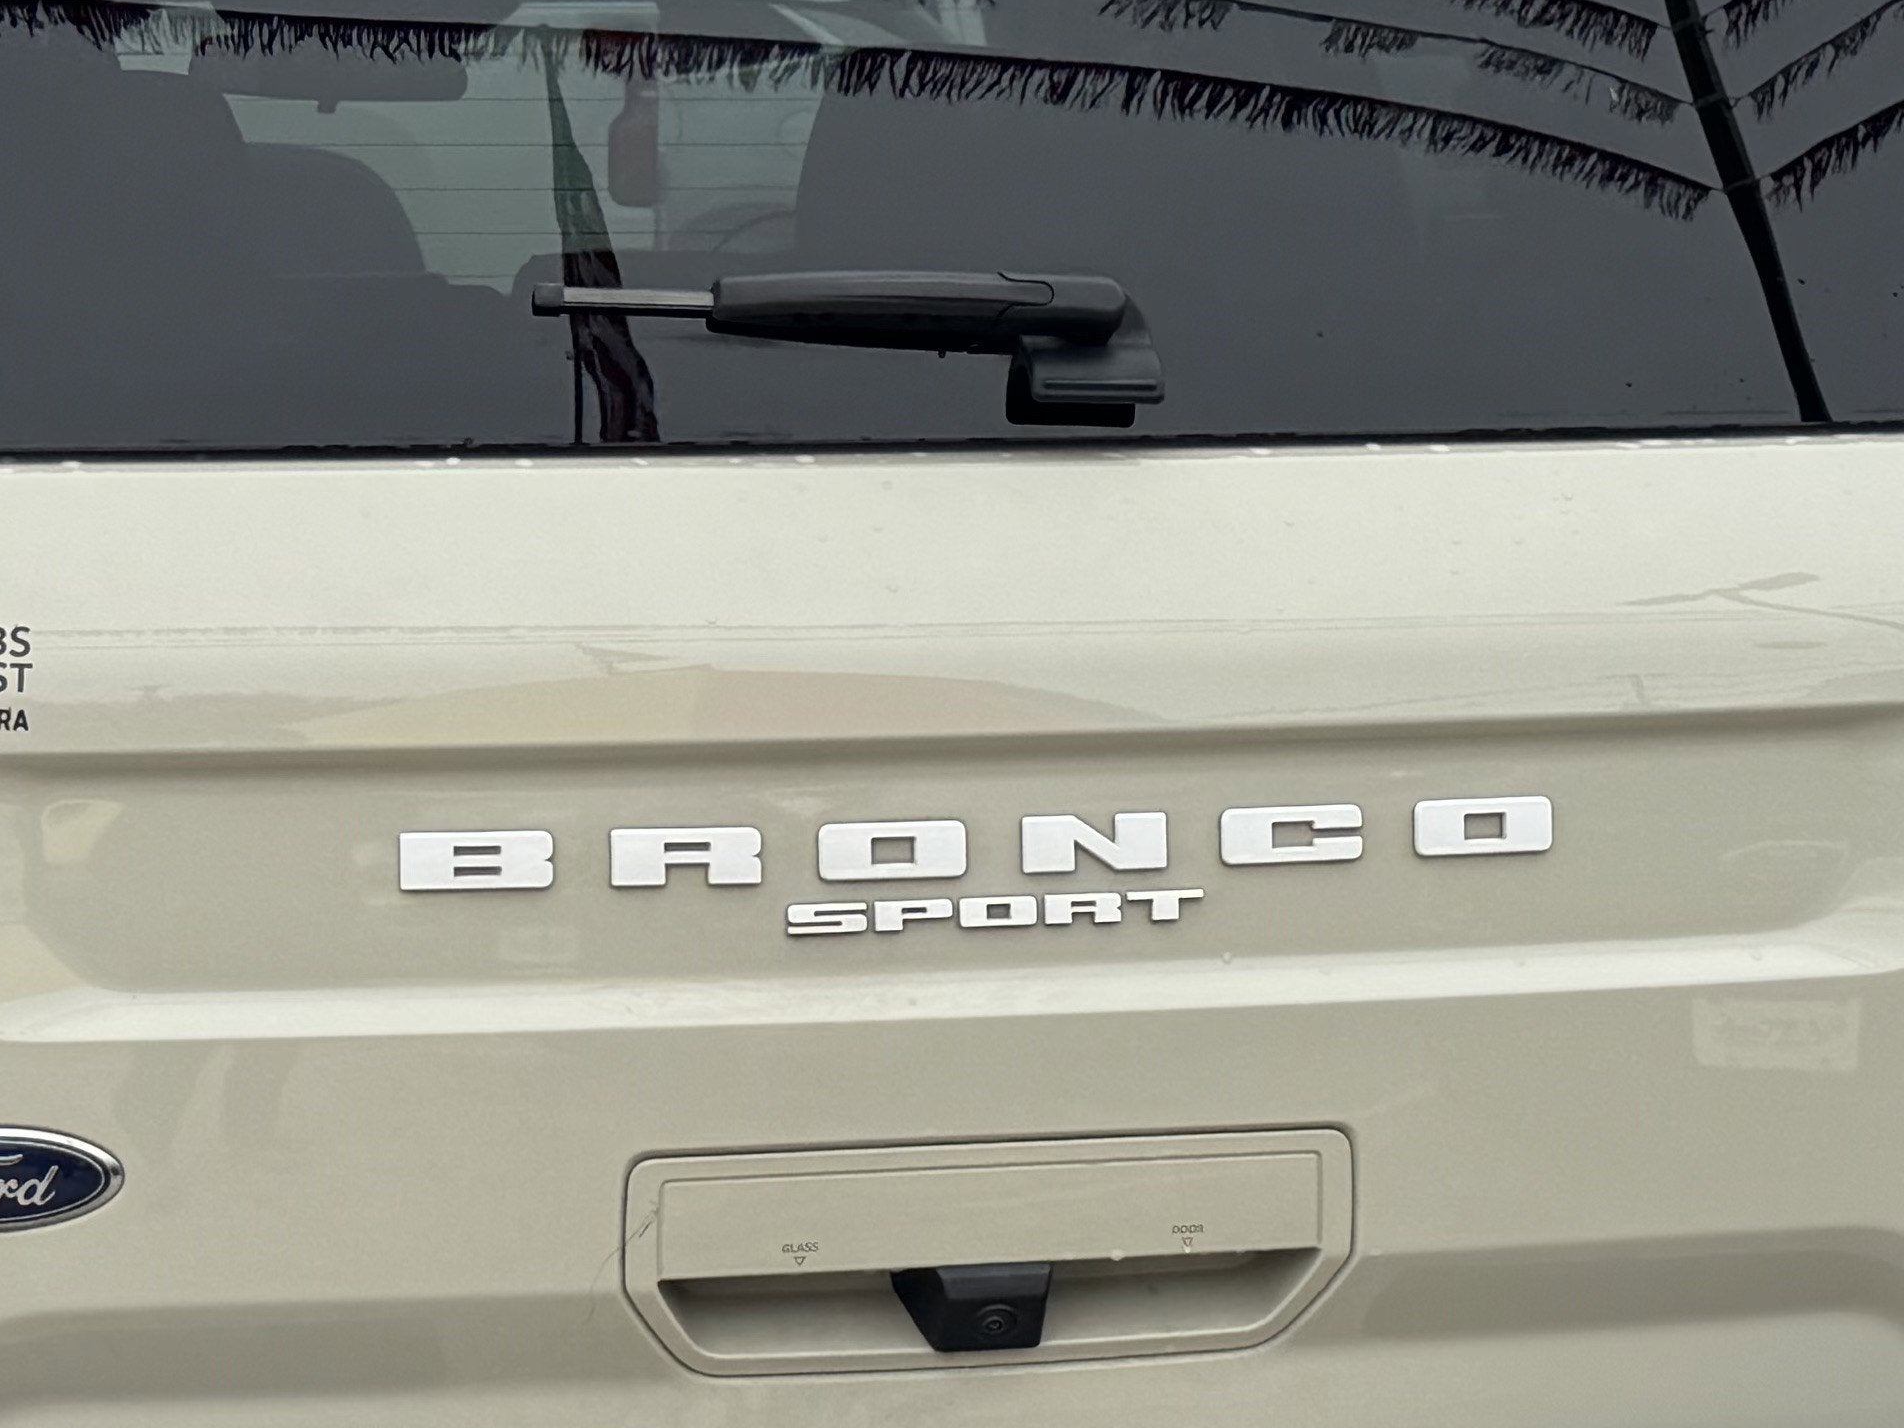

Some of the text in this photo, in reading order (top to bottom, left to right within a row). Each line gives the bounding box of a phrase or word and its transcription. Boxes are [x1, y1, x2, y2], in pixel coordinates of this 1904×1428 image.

[399, 795, 1554, 892] BRONCO
[785, 889, 1204, 936] SPORT
[781, 1241, 819, 1253] GLASS
